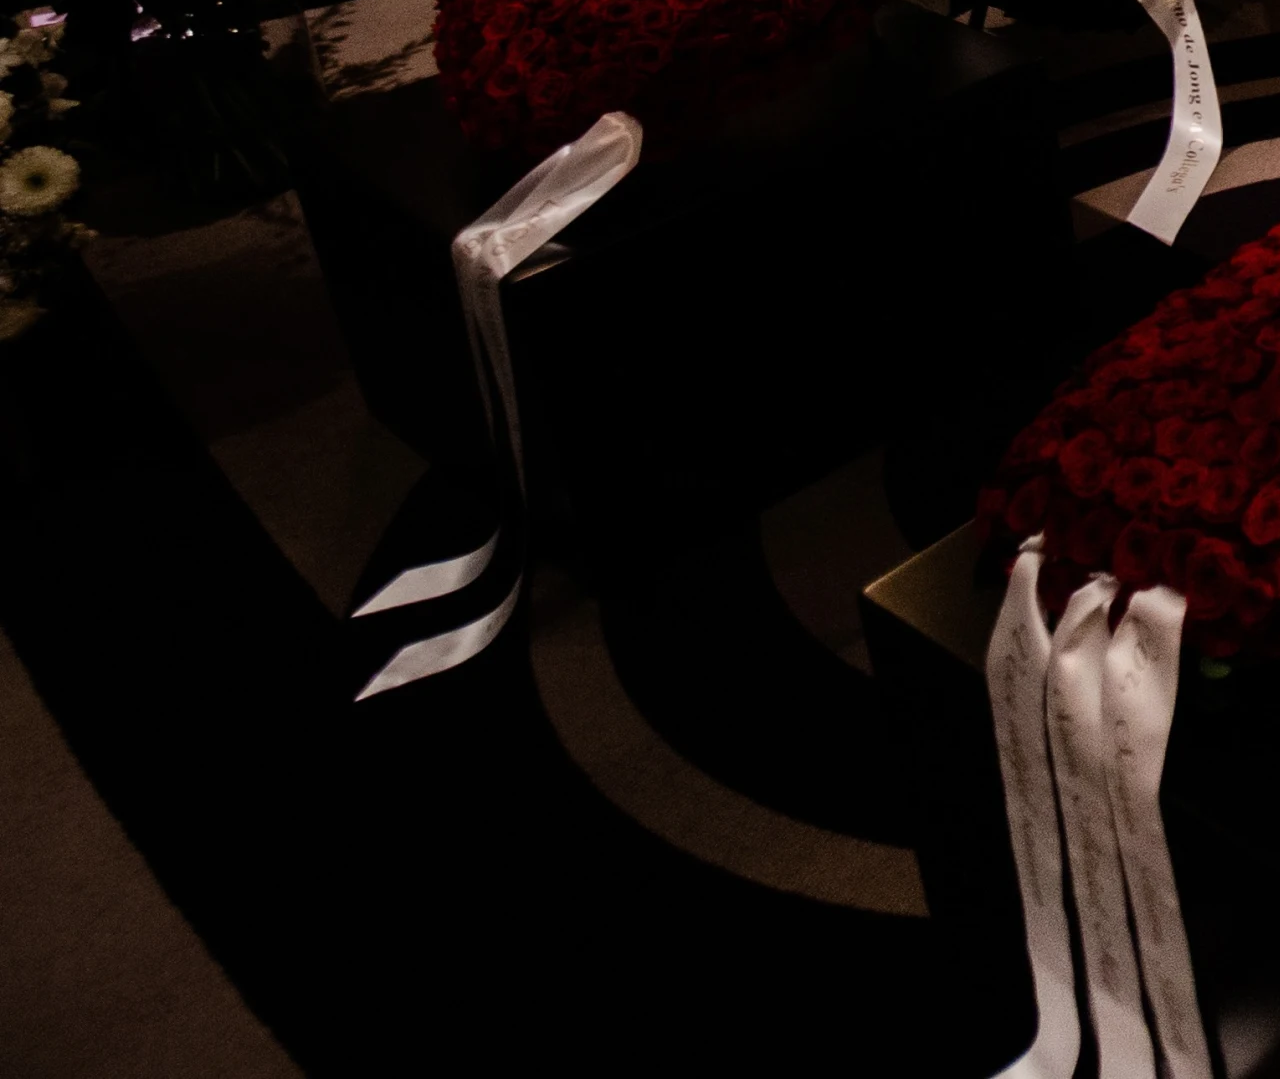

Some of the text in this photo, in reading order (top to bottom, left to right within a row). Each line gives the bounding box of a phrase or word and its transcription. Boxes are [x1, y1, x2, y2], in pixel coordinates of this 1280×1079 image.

[1183, 32, 1196, 55] de
[1186, 58, 1202, 105] Jong
[1165, 132, 1206, 194] Collega's
